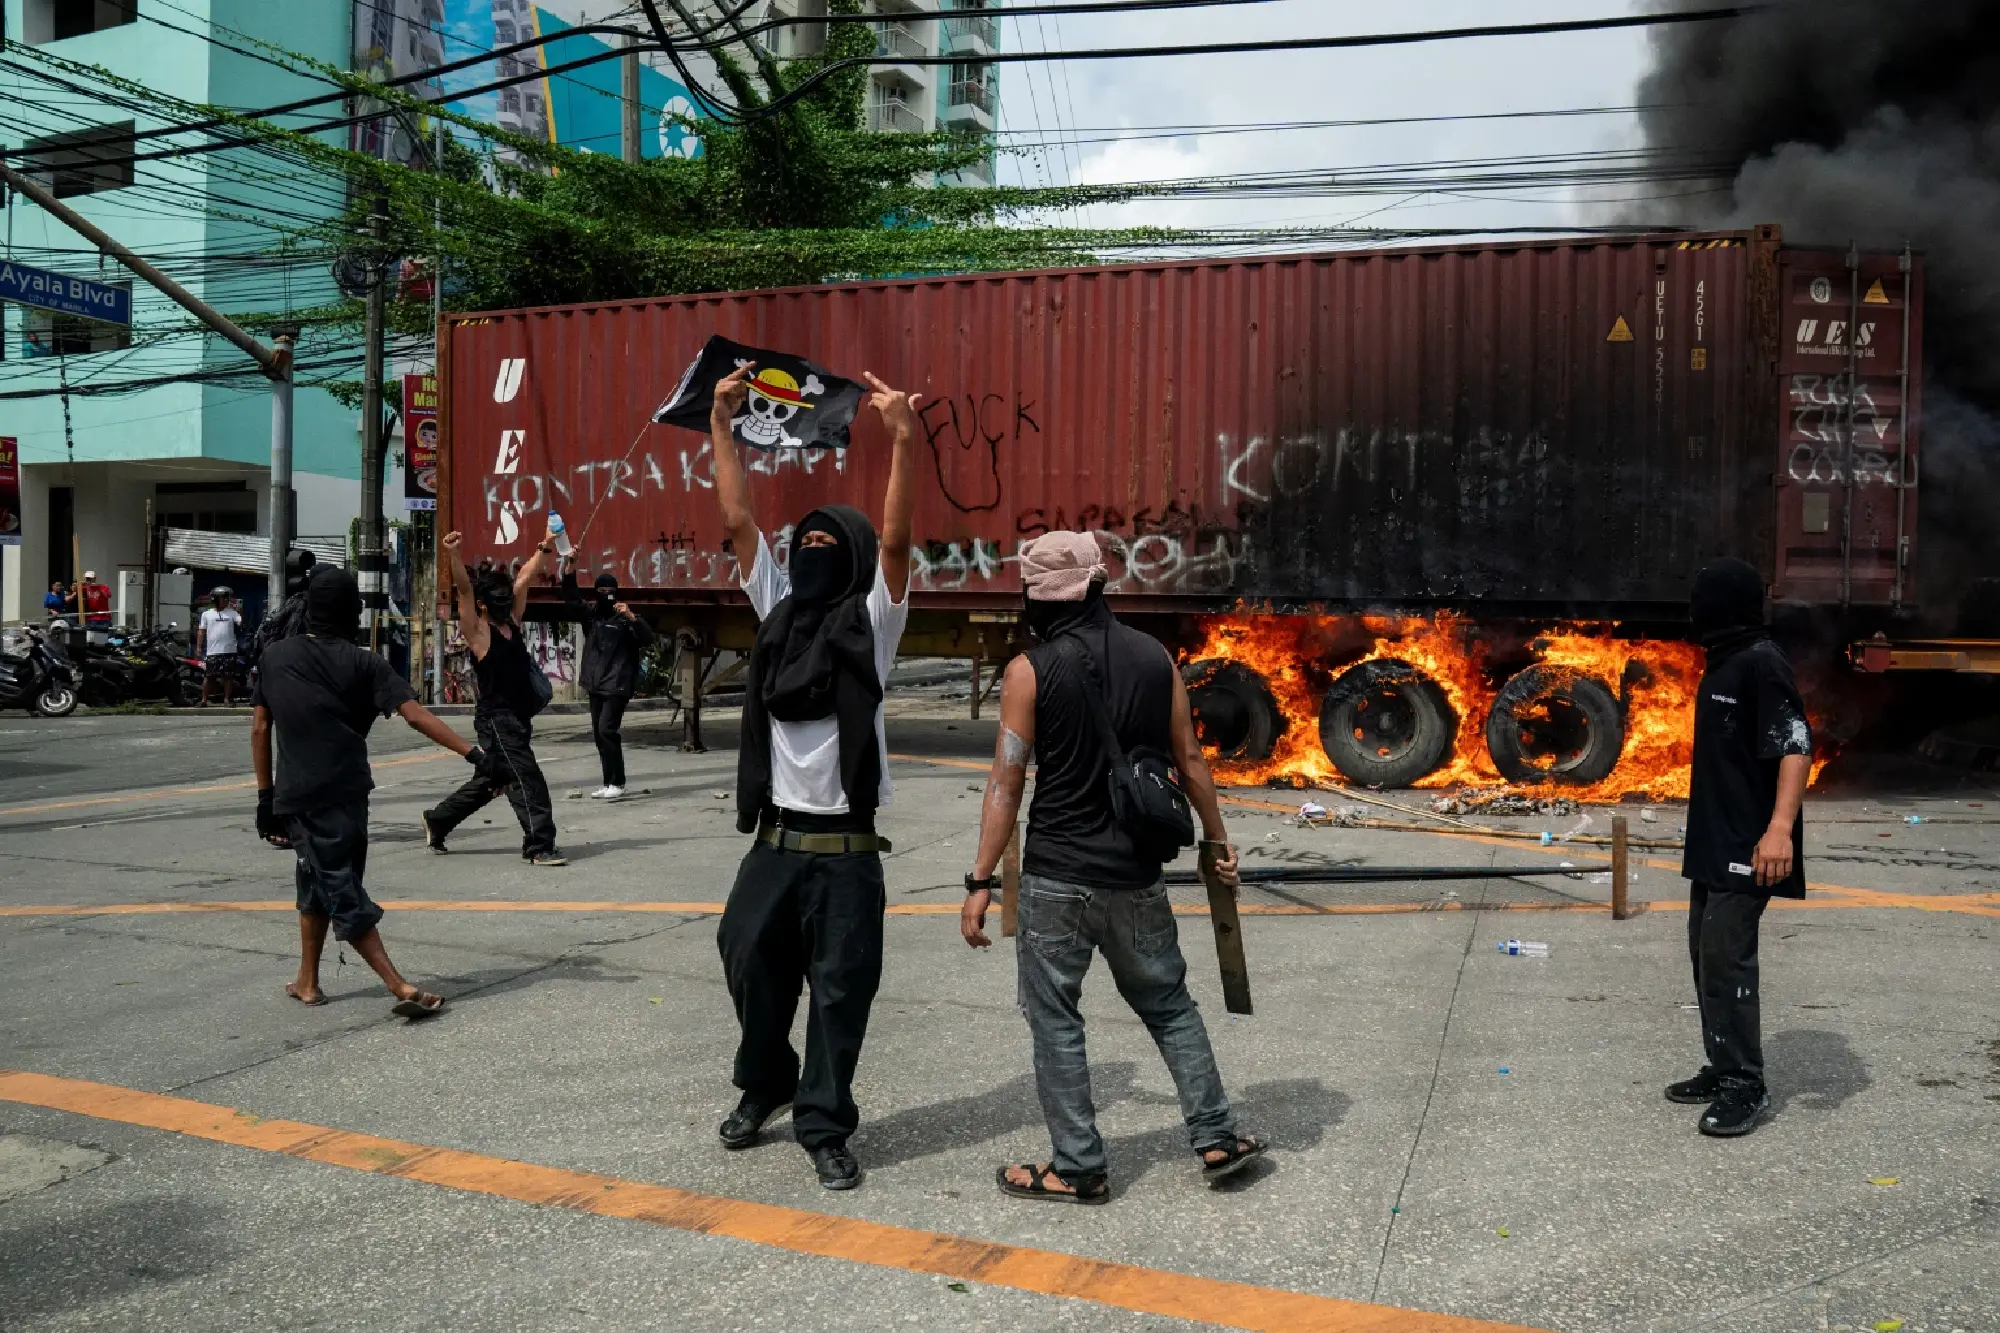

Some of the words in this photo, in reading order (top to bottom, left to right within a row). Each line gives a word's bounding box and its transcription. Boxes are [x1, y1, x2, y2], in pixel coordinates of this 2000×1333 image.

[0, 263, 63, 294] Ayala
[69, 280, 116, 307] Blvd
[28, 293, 45, 305] CITY
[49, 298, 59, 307] OF
[61, 301, 90, 313] MANILA
[1655, 280, 1665, 341] UETU
[1696, 280, 1704, 341] 45G1
[918, 391, 1040, 450] FUCK
[483, 452, 665, 521] KONTRA
